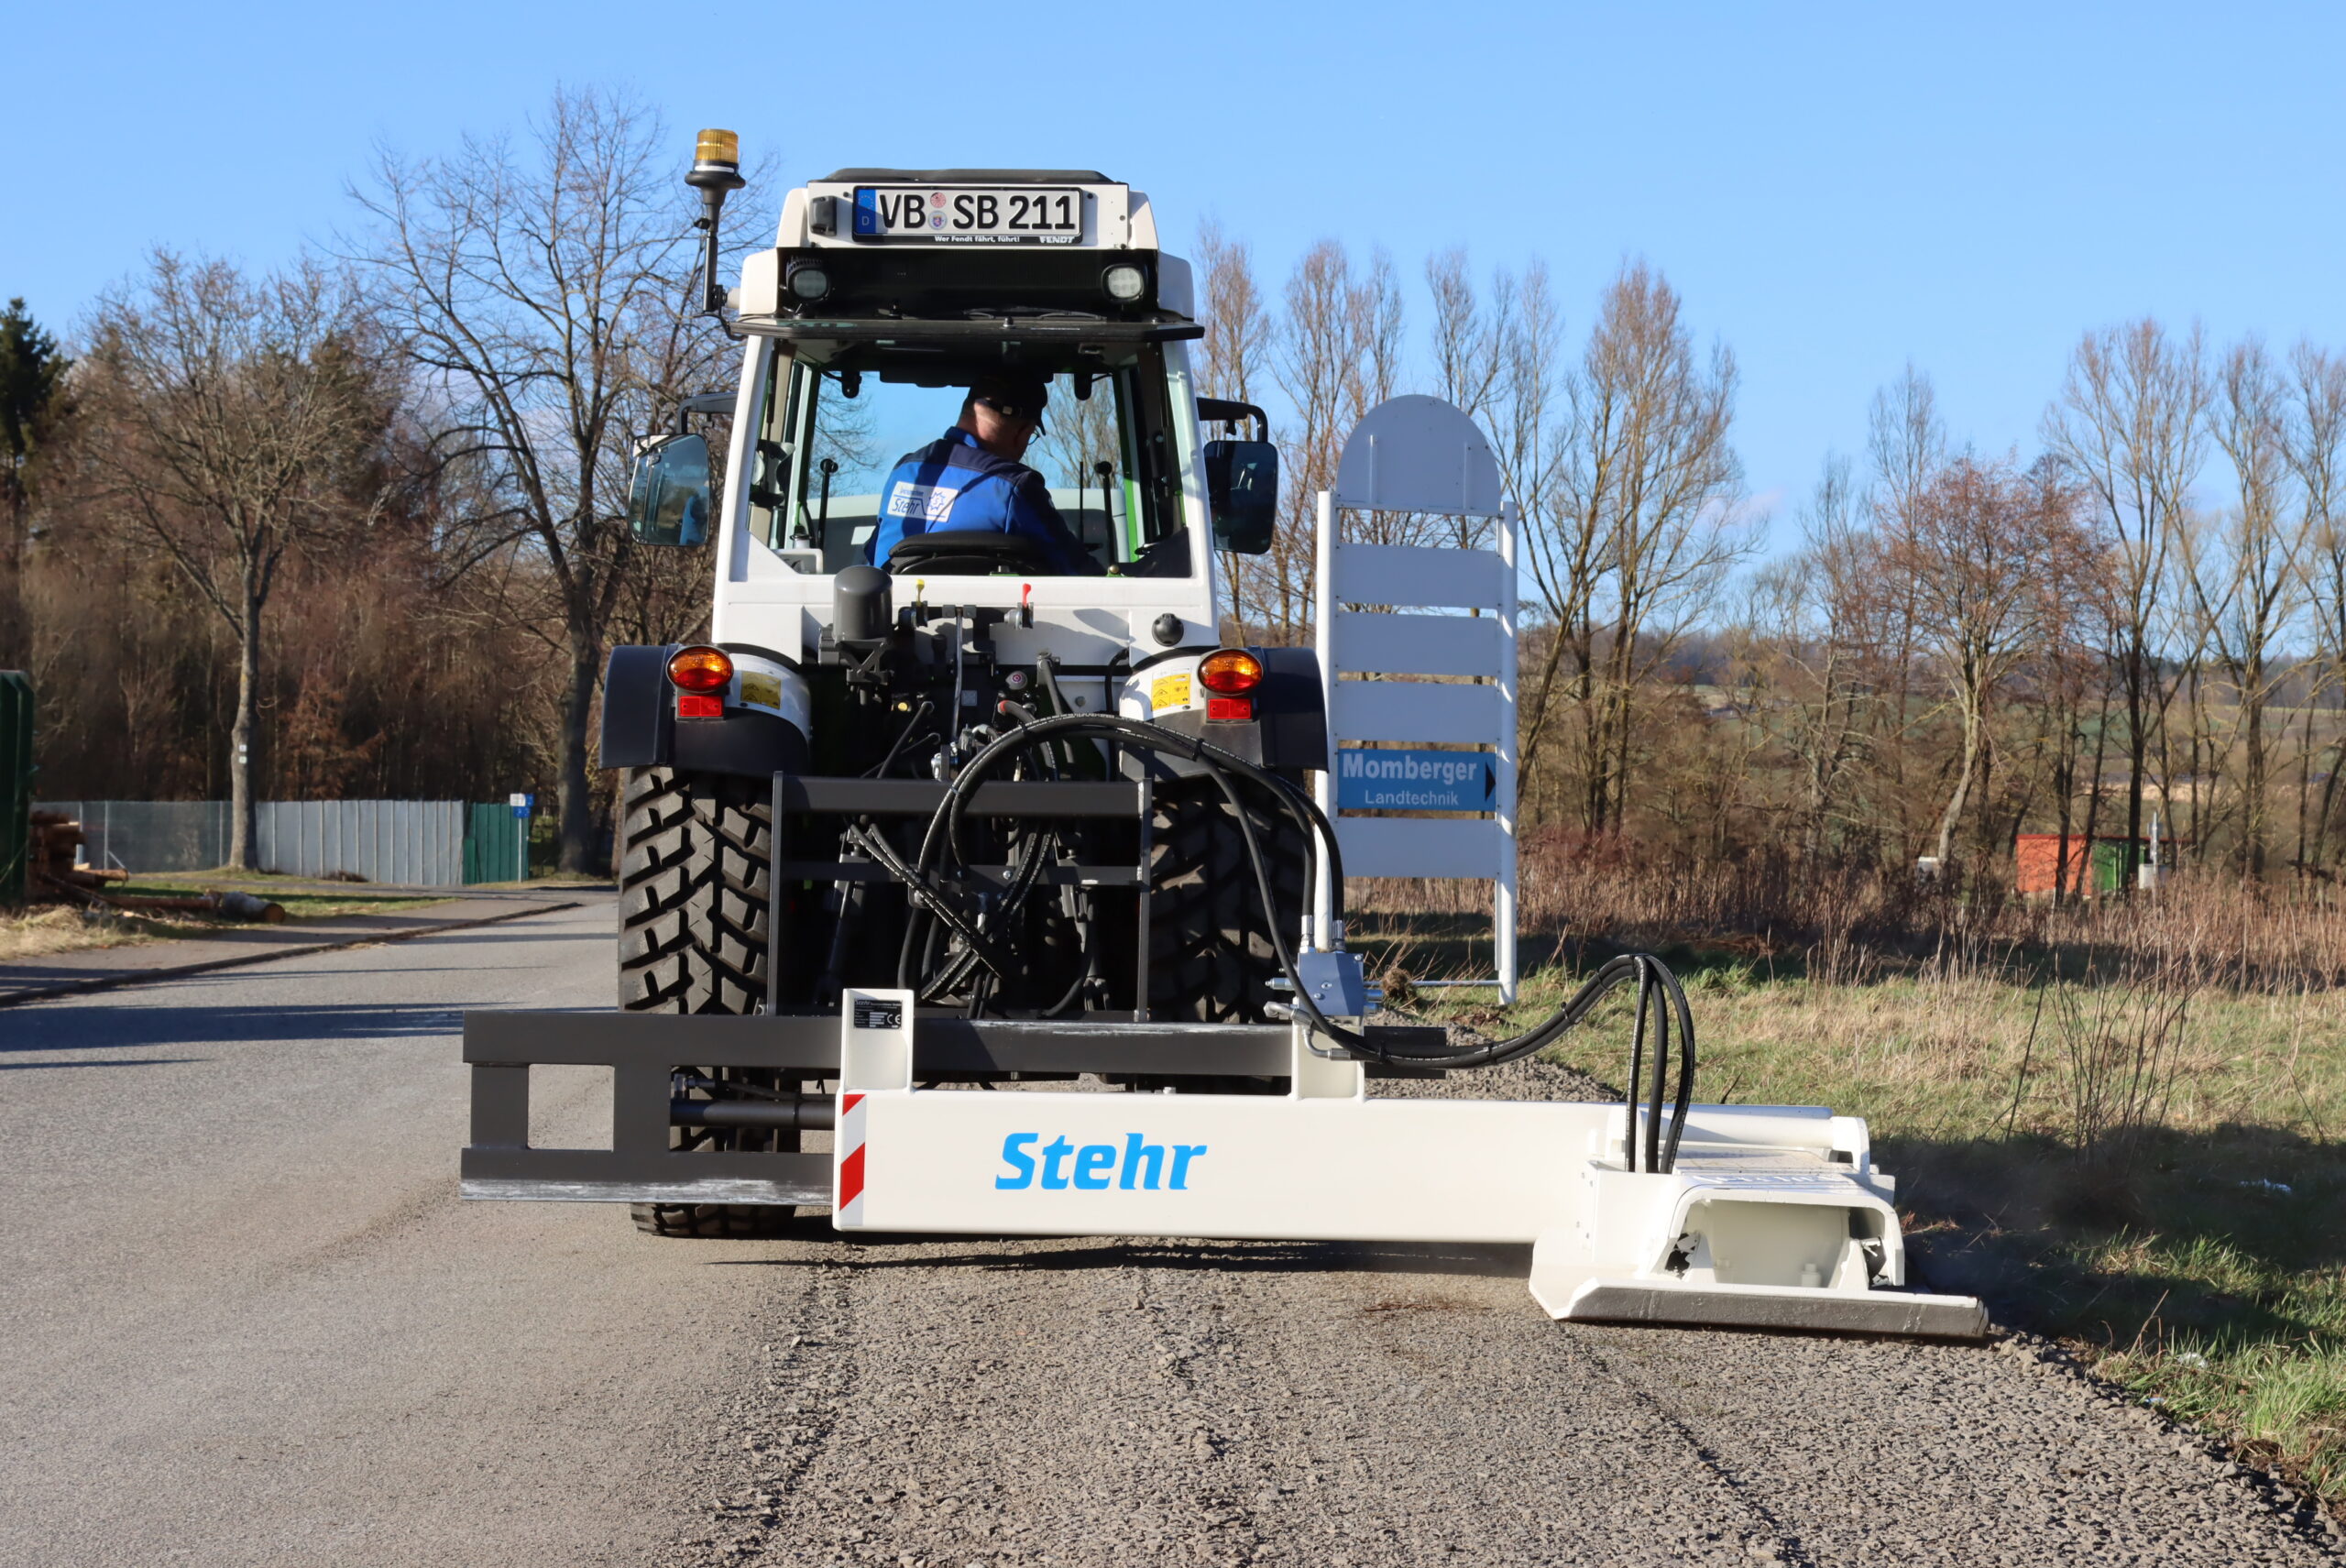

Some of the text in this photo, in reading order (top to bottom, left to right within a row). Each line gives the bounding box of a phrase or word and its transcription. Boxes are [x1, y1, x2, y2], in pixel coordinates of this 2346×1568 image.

[880, 194, 1076, 229] VB SB 211
[861, 215, 870, 226] D
[974, 235, 995, 244] fährt,
[997, 235, 1020, 243] führt!
[1039, 236, 1076, 244] FENDT
[892, 499, 920, 514] Stehr
[1343, 752, 1478, 785] Momberger
[1365, 789, 1459, 806] Landtechnik
[994, 1133, 1208, 1190] Stehr
